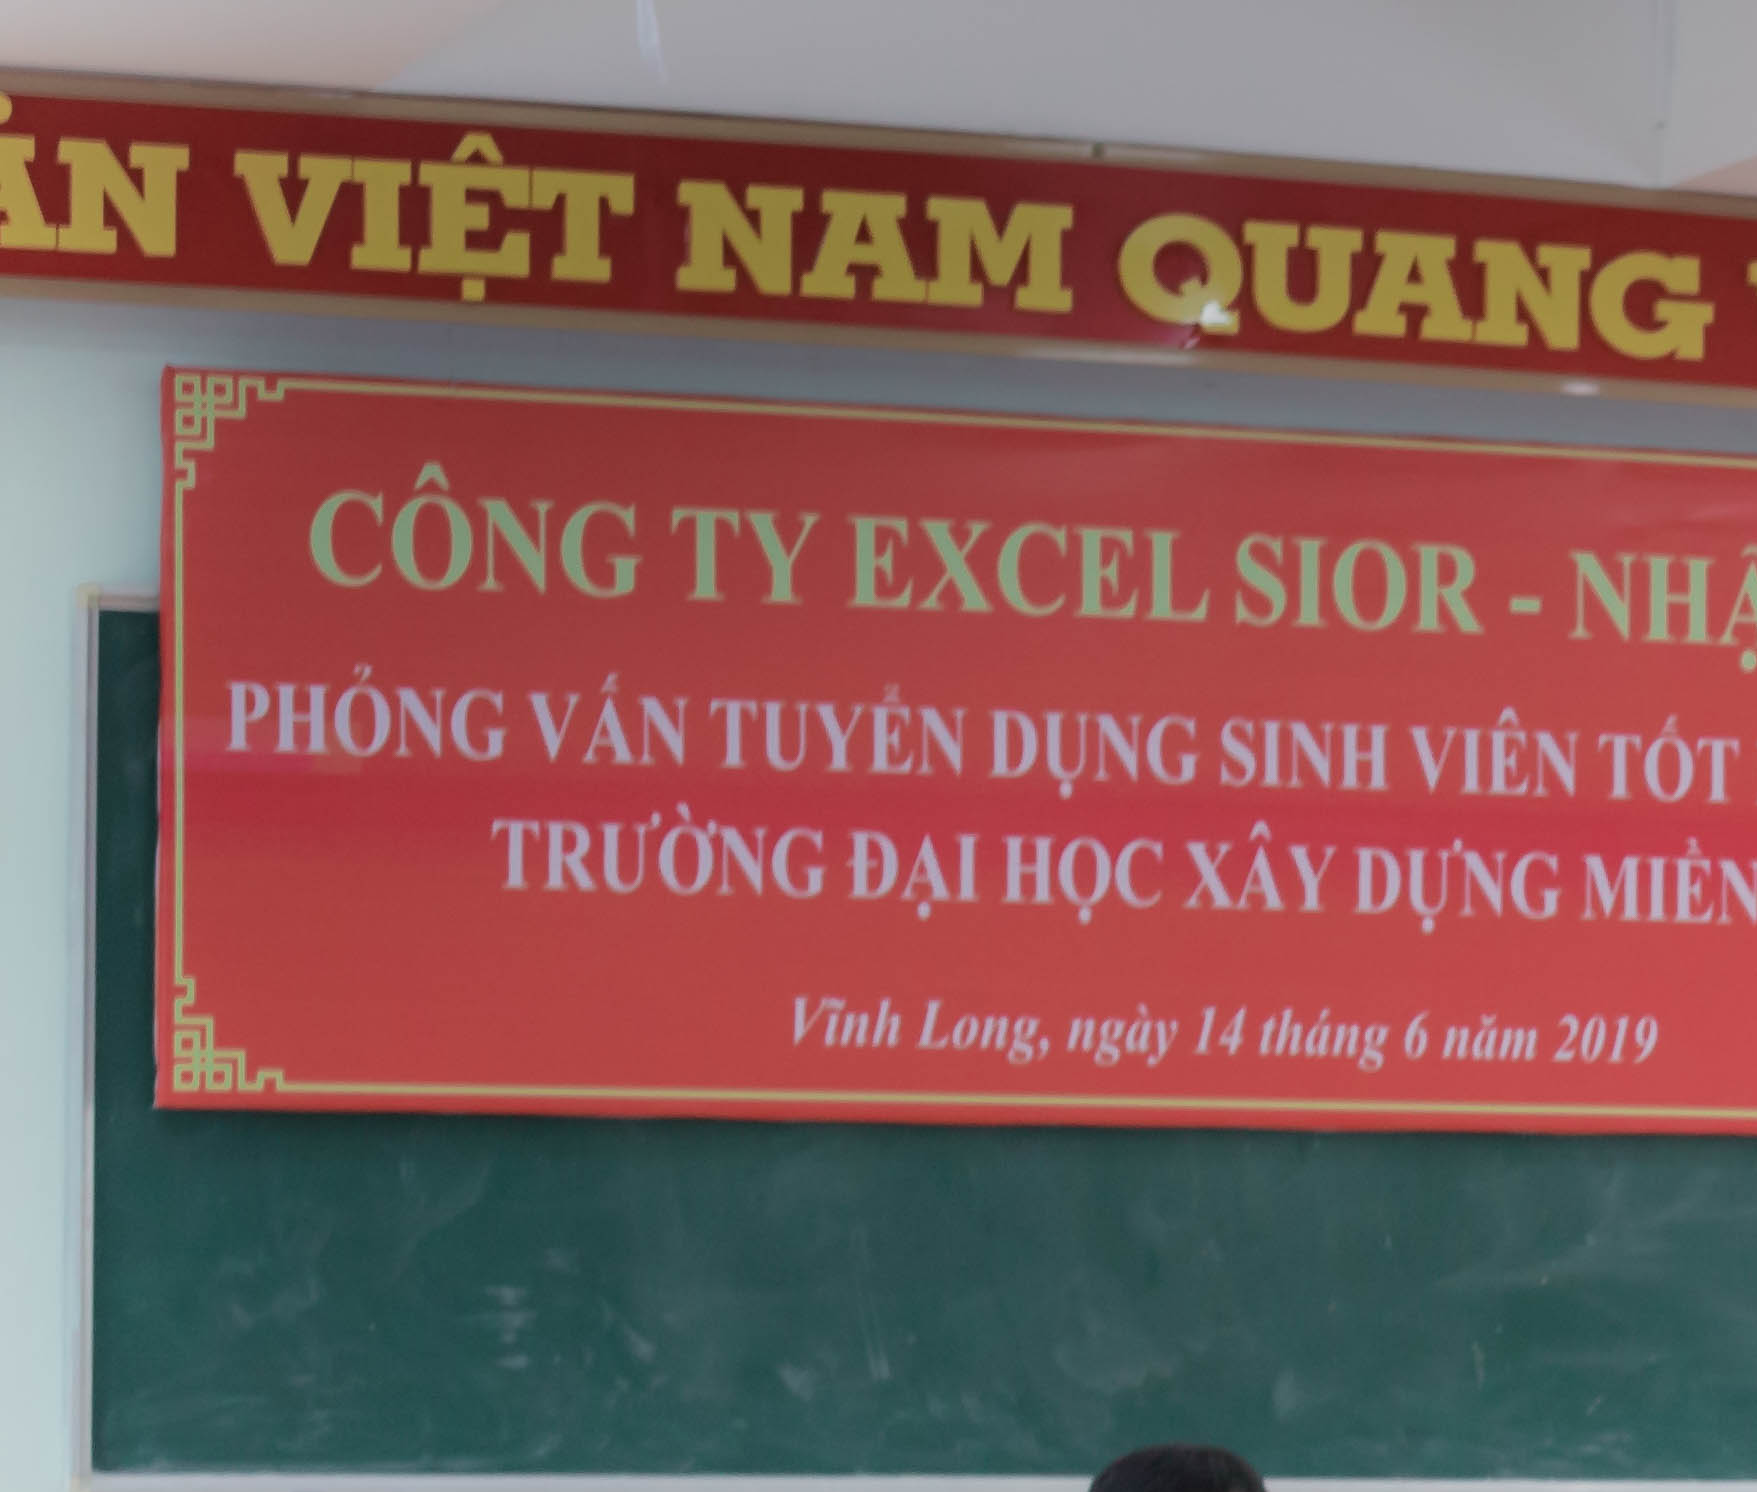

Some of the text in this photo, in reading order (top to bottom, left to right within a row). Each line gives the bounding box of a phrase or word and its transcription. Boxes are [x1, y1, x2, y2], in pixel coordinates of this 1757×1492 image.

[234, 133, 635, 302] VIỆT
[678, 183, 1074, 312] NAM
[1118, 214, 1714, 358] QUANG
[308, 461, 642, 599] CÔNG
[670, 506, 820, 605] TY
[850, 515, 1211, 624] EXCEL
[1234, 533, 1484, 635] SIOR
[1508, 595, 1543, 616] -
[226, 664, 507, 762] PHỎNG
[528, 672, 689, 766] VẤN
[709, 681, 966, 777] TUYỂN
[990, 708, 1199, 800] DỤNG
[1219, 718, 1389, 792] SINH
[1410, 705, 1579, 798] VIÊN
[1597, 714, 1741, 805] TỐT
[490, 801, 826, 900] TRƯỜNG
[847, 830, 979, 922] ĐẠI
[1002, 835, 1164, 926] HỌC
[1183, 820, 1336, 912] XÂY
[1354, 838, 1562, 936] DỰNG
[792, 995, 1660, 1072] Vĩnh Long, ngày 14 tháng 6 năm 2019
